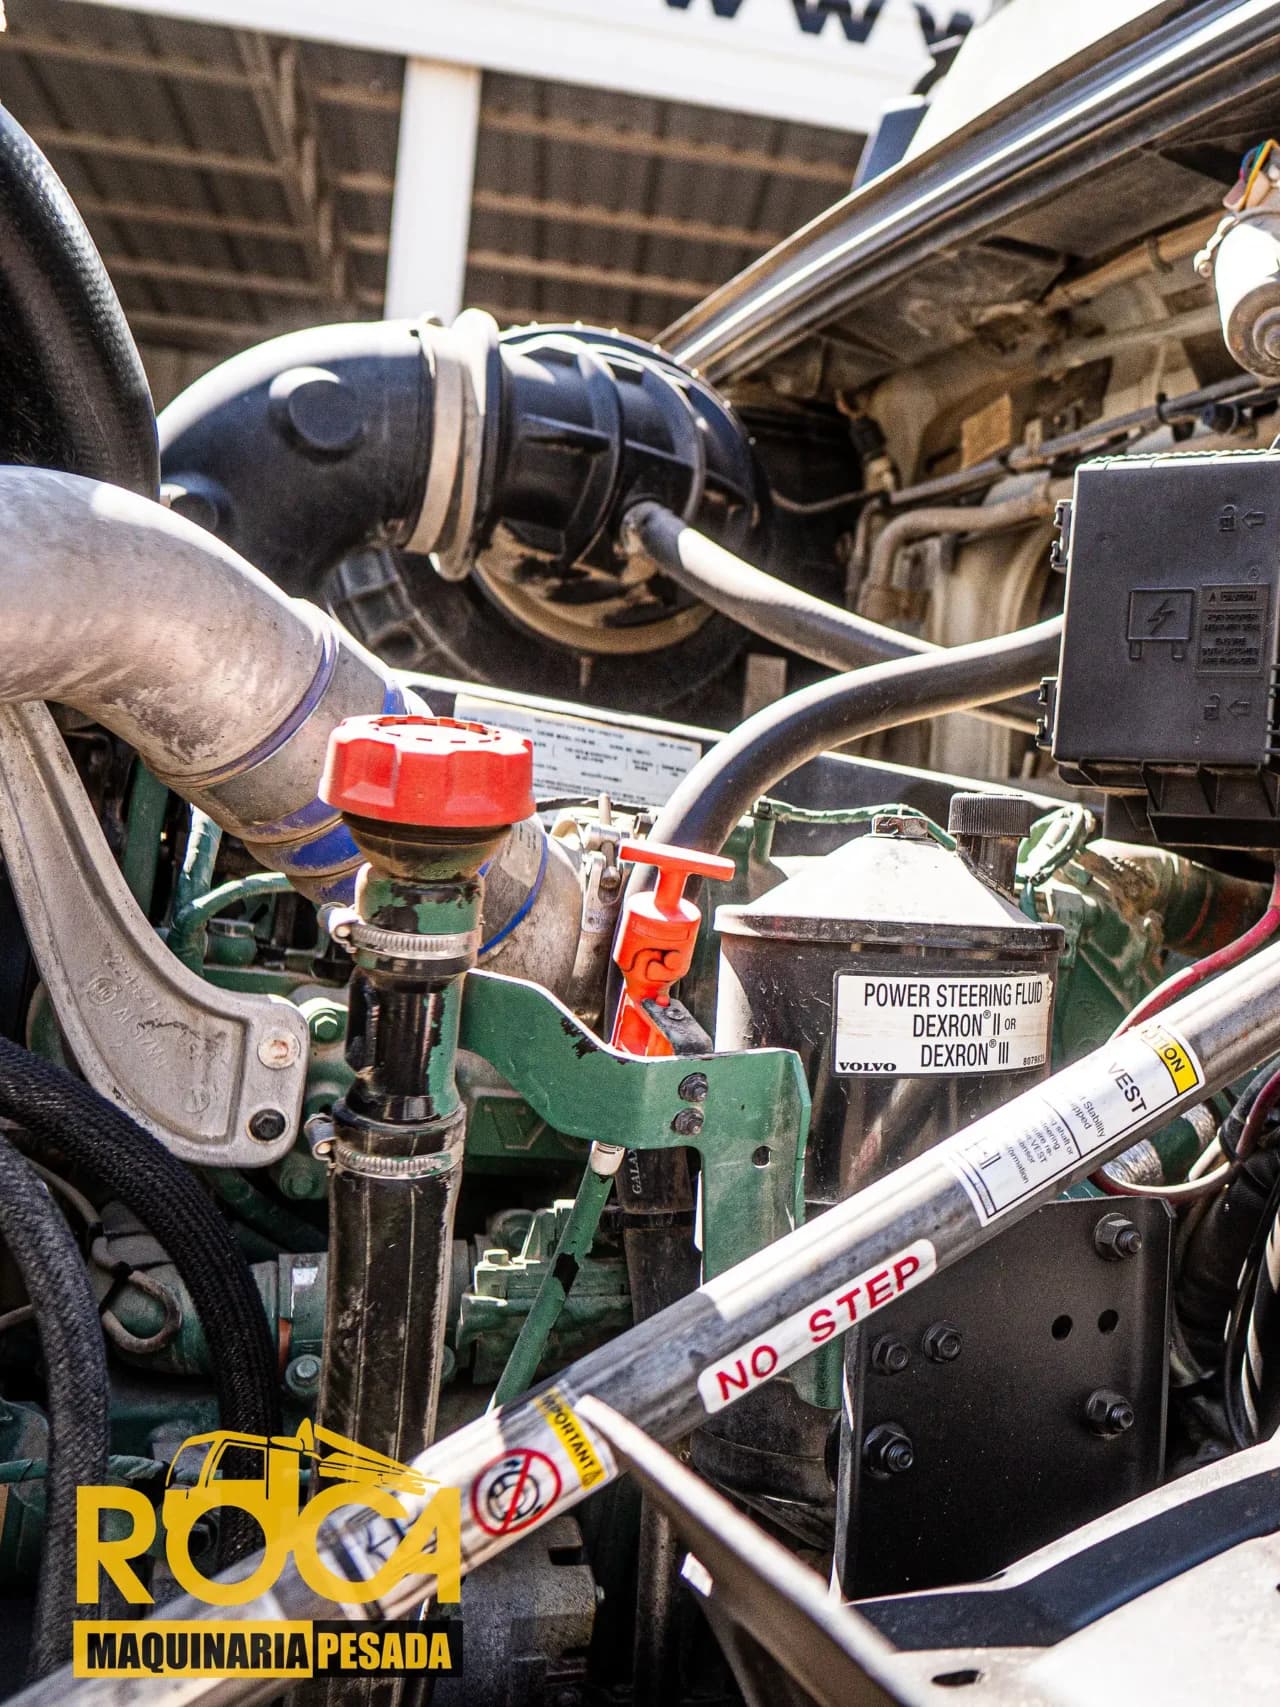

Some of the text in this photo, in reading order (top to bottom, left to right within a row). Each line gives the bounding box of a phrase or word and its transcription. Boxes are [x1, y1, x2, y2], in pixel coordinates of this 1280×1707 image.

[864, 981, 1043, 1008] POWER STEERING FLUID
[992, 1013, 1000, 1036] II
[1004, 1018, 1016, 1031] OR
[998, 1042, 1009, 1064] III
[838, 1062, 896, 1072] VOLVO
[1107, 1062, 1148, 1114] VEST
[1083, 1100, 1106, 1138] Stability
[716, 1255, 921, 1401] NO STEP
